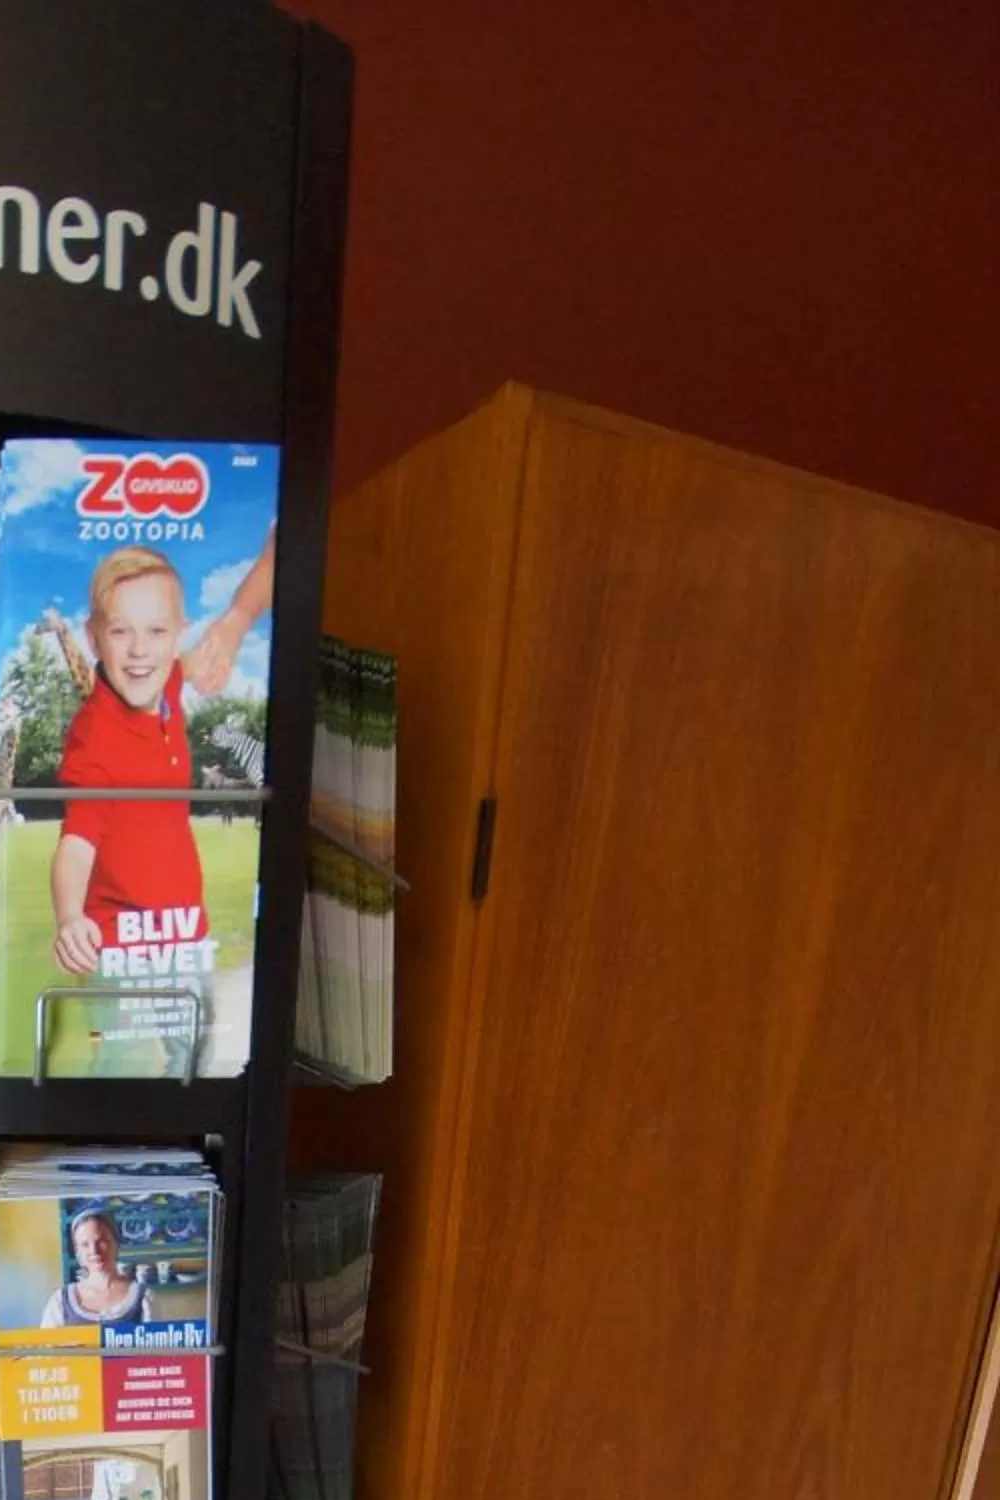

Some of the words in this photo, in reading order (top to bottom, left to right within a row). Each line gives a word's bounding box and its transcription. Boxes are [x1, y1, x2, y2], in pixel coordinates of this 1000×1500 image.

[129, 477, 199, 495] GIVSKUD
[78, 521, 205, 541] ZOOTOPIA
[117, 906, 201, 943] BLIV
[101, 939, 218, 978] REVET
